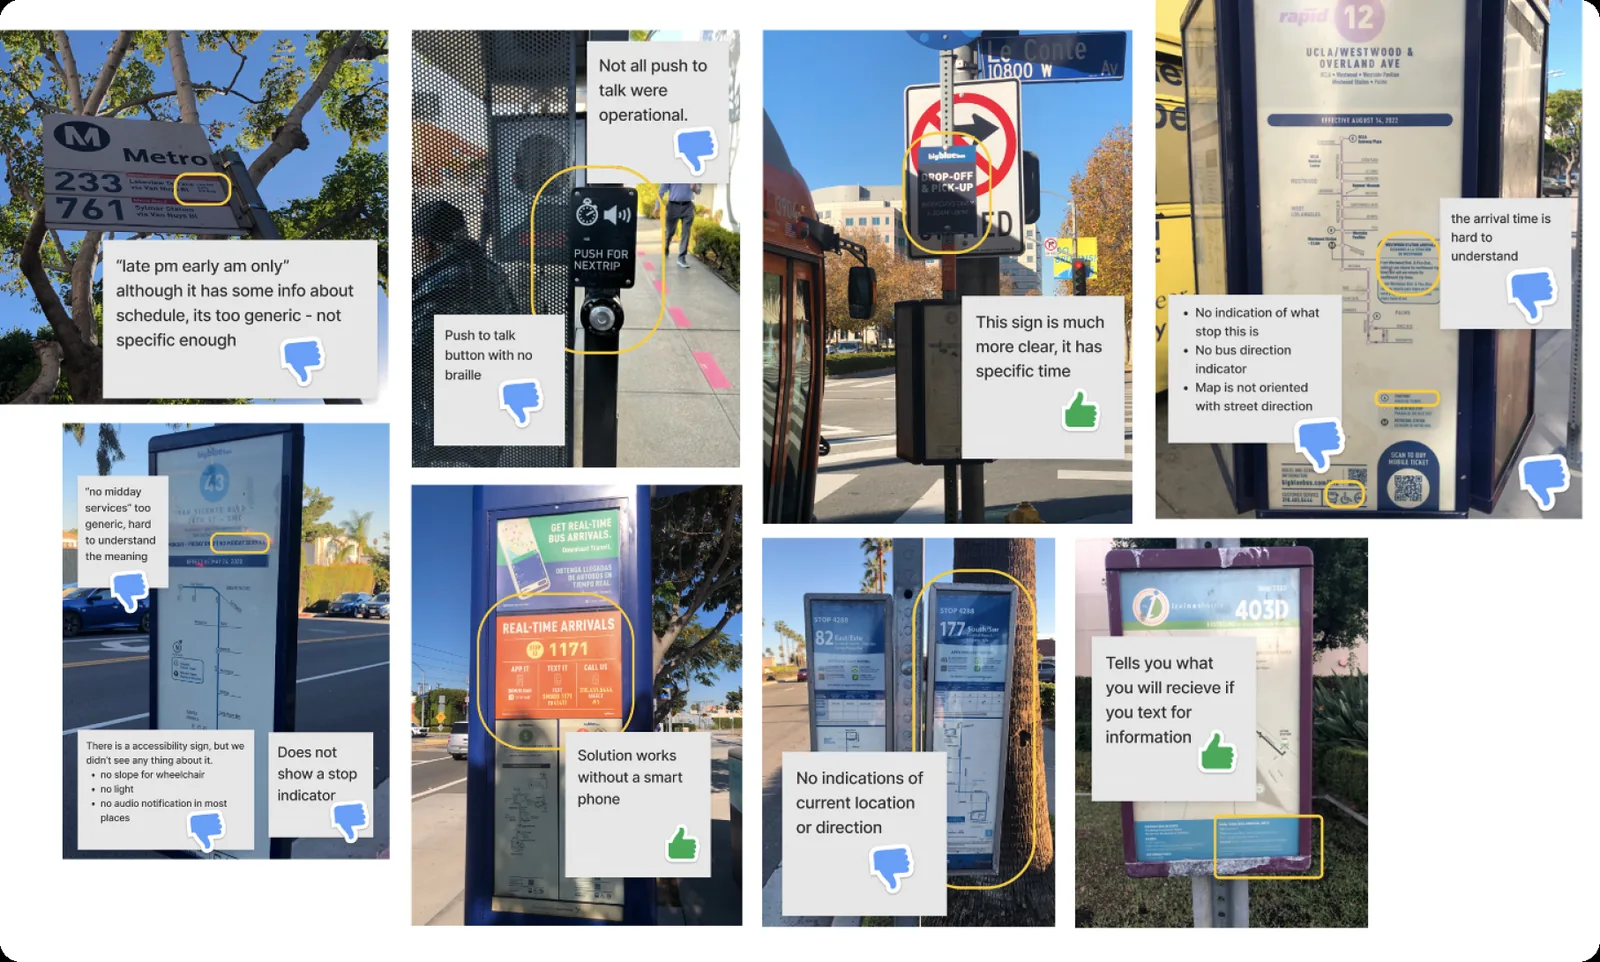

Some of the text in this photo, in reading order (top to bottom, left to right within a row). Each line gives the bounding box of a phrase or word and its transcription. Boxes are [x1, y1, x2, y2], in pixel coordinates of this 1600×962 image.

[1279, 8, 1329, 26] rapid
[1344, 4, 1374, 29] 12
[987, 39, 1087, 63] Le Conte
[1306, 47, 1414, 58] UCLA/WESTWOOD &
[987, 59, 1118, 79] 10800 W Av
[1319, 58, 1401, 69] OVERLAND AVE
[64, 125, 101, 147] M
[122, 148, 208, 166] Metro
[54, 171, 122, 193] 233
[921, 171, 974, 182] DROP-OFF
[931, 182, 974, 193] PICK-UP
[55, 197, 124, 221] 761
[574, 249, 629, 260] PUSH FOR
[574, 261, 621, 271] NEXTRIP
[204, 473, 225, 492] 43
[551, 518, 612, 533] GET REAL-TIME
[549, 529, 612, 544] BUS ARRIVALS.
[939, 607, 975, 615] STOP 4288
[1235, 599, 1289, 621] 403D
[502, 617, 615, 635] REAL-TIME ARRIVALS
[940, 621, 966, 637] 177
[815, 630, 834, 646] 82
[549, 641, 588, 657] 1171
[510, 665, 523, 673] APP
[599, 663, 608, 671] US
